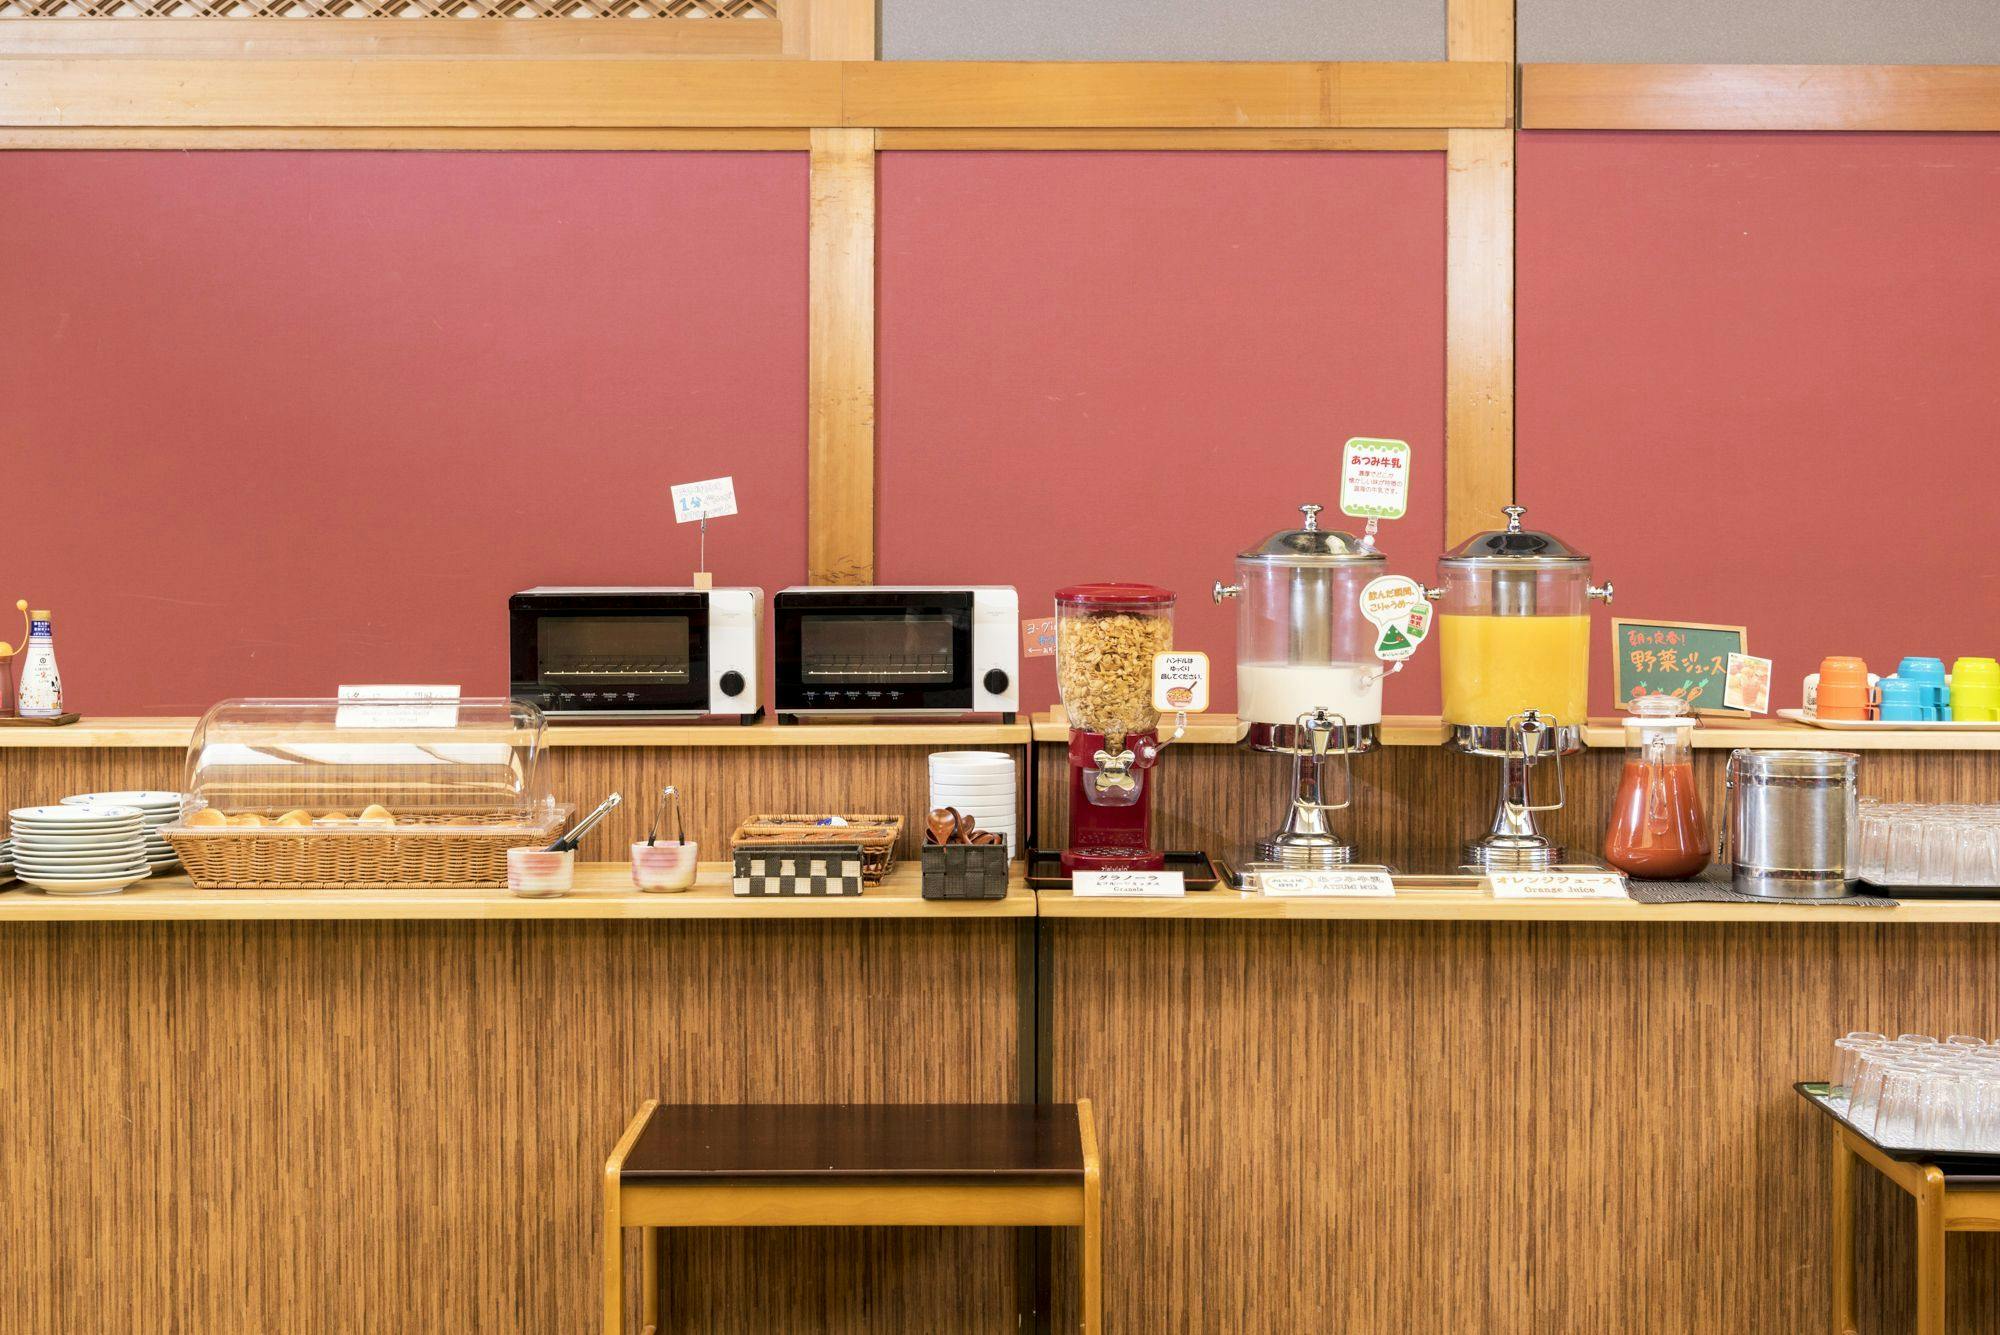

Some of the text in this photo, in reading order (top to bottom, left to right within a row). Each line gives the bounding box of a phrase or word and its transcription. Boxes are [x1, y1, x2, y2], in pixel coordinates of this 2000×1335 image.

[1351, 455, 1402, 469] あつみ牛乳
[1630, 648, 1727, 676] 野菜ジュース
[1497, 876, 1616, 885] オレンジジュース
[1524, 886, 1564, 894] Orange
